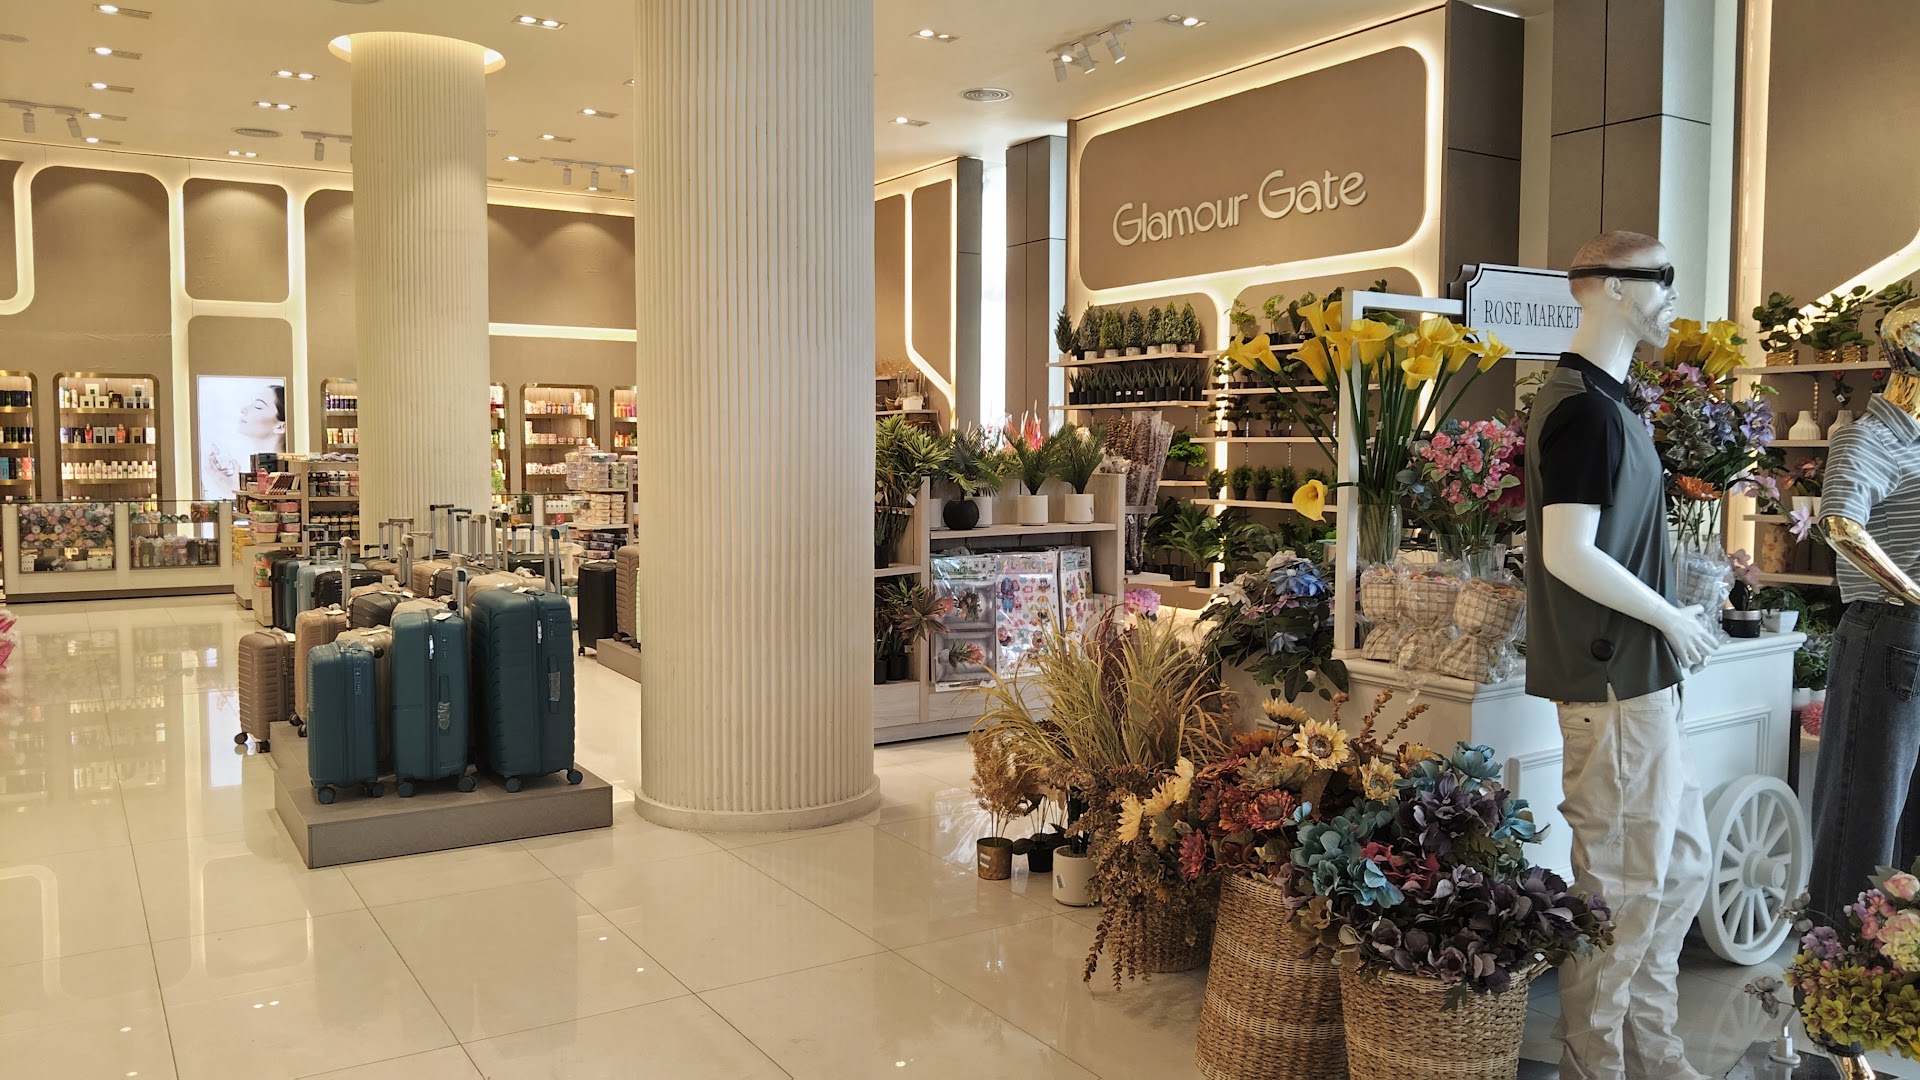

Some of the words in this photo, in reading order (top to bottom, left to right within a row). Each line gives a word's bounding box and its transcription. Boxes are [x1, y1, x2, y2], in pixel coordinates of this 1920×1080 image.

[1112, 193, 1249, 246] Glamour
[1258, 169, 1368, 219] Gate
[1484, 299, 1522, 325] ROSE
[1526, 303, 1583, 329] MARKET
